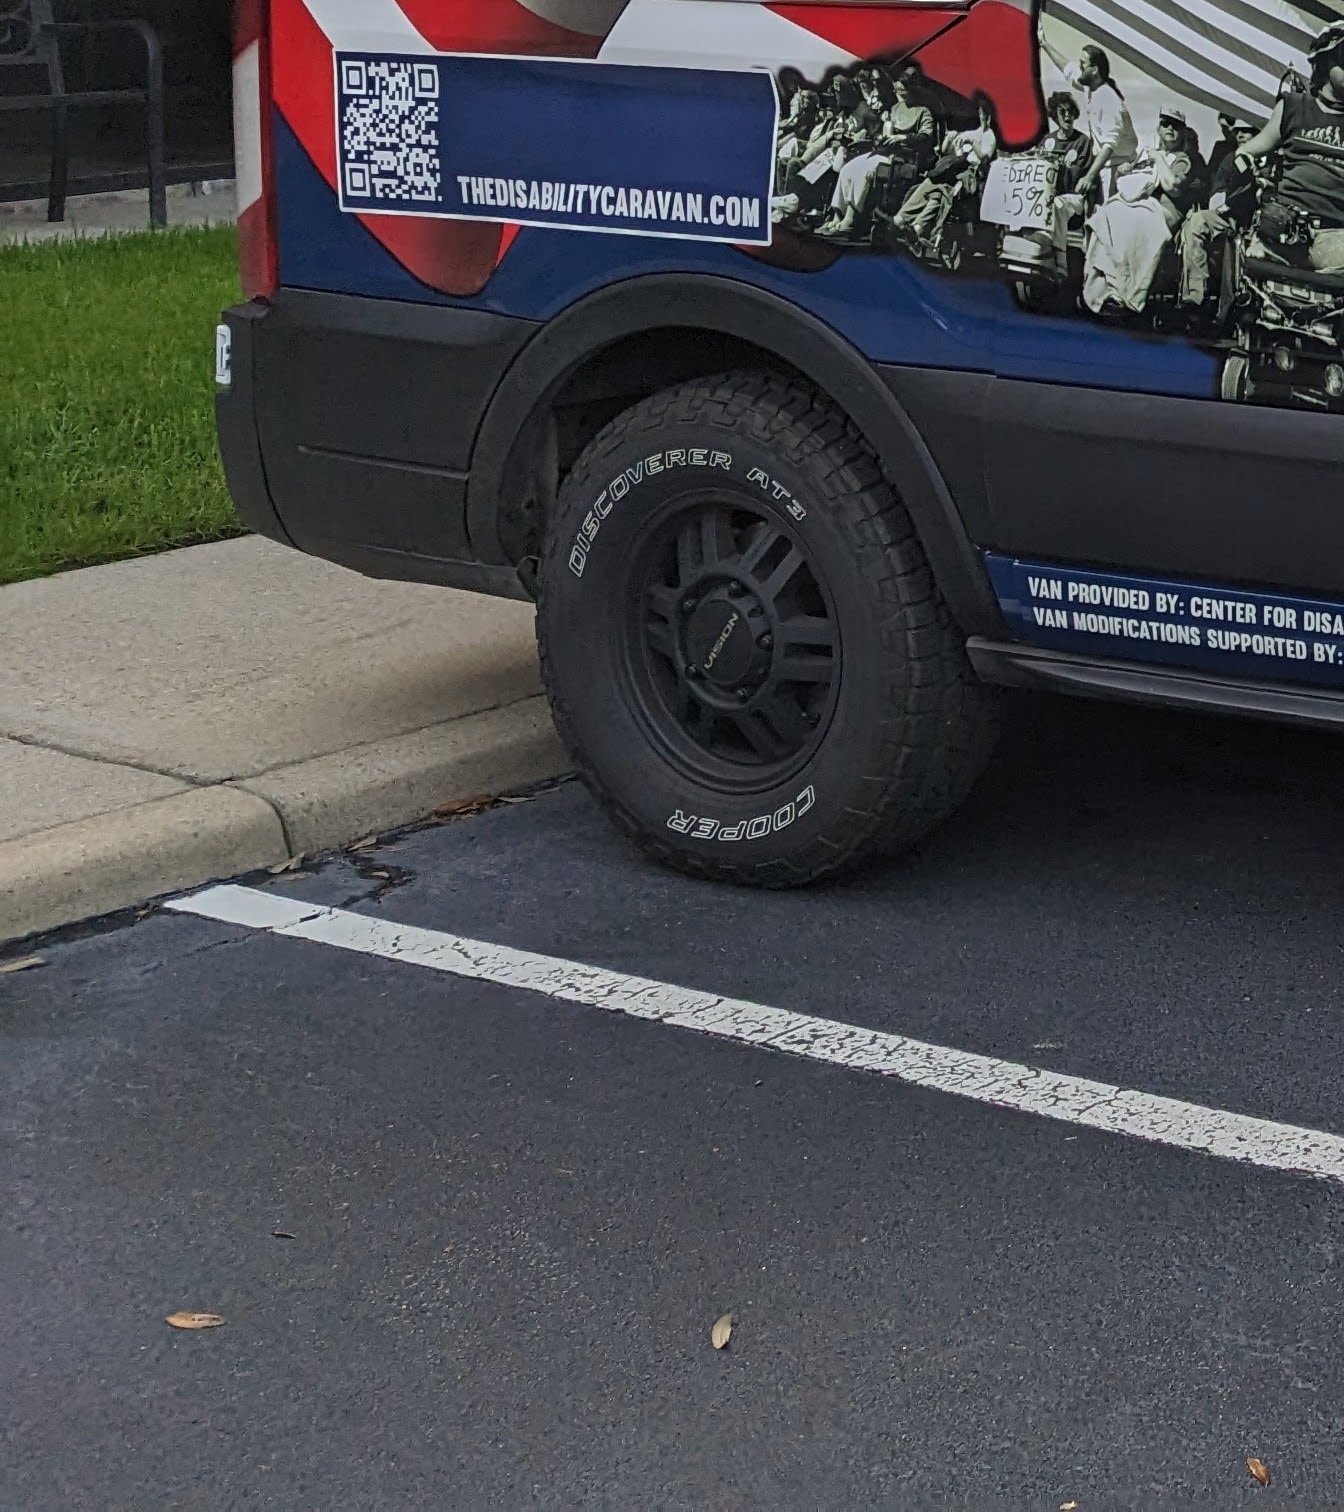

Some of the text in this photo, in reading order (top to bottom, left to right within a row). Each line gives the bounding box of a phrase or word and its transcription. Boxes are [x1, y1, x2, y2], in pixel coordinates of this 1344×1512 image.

[457, 175, 760, 228] THEDISABILITYCARAVAN.COM
[569, 448, 807, 578] DISCOVERER AT3
[1028, 576, 1062, 601] VAN
[1068, 581, 1149, 611] PROVIDED
[1155, 593, 1185, 615] BY:
[1190, 596, 1257, 624] CENTER
[1263, 605, 1297, 630] FOR
[1033, 606, 1068, 629] VAN
[1073, 611, 1201, 646] MODIFICATIONS
[1207, 628, 1307, 660] SUPPORTED
[1314, 642, 1343, 665] BY:
[667, 785, 816, 842] COOPER
